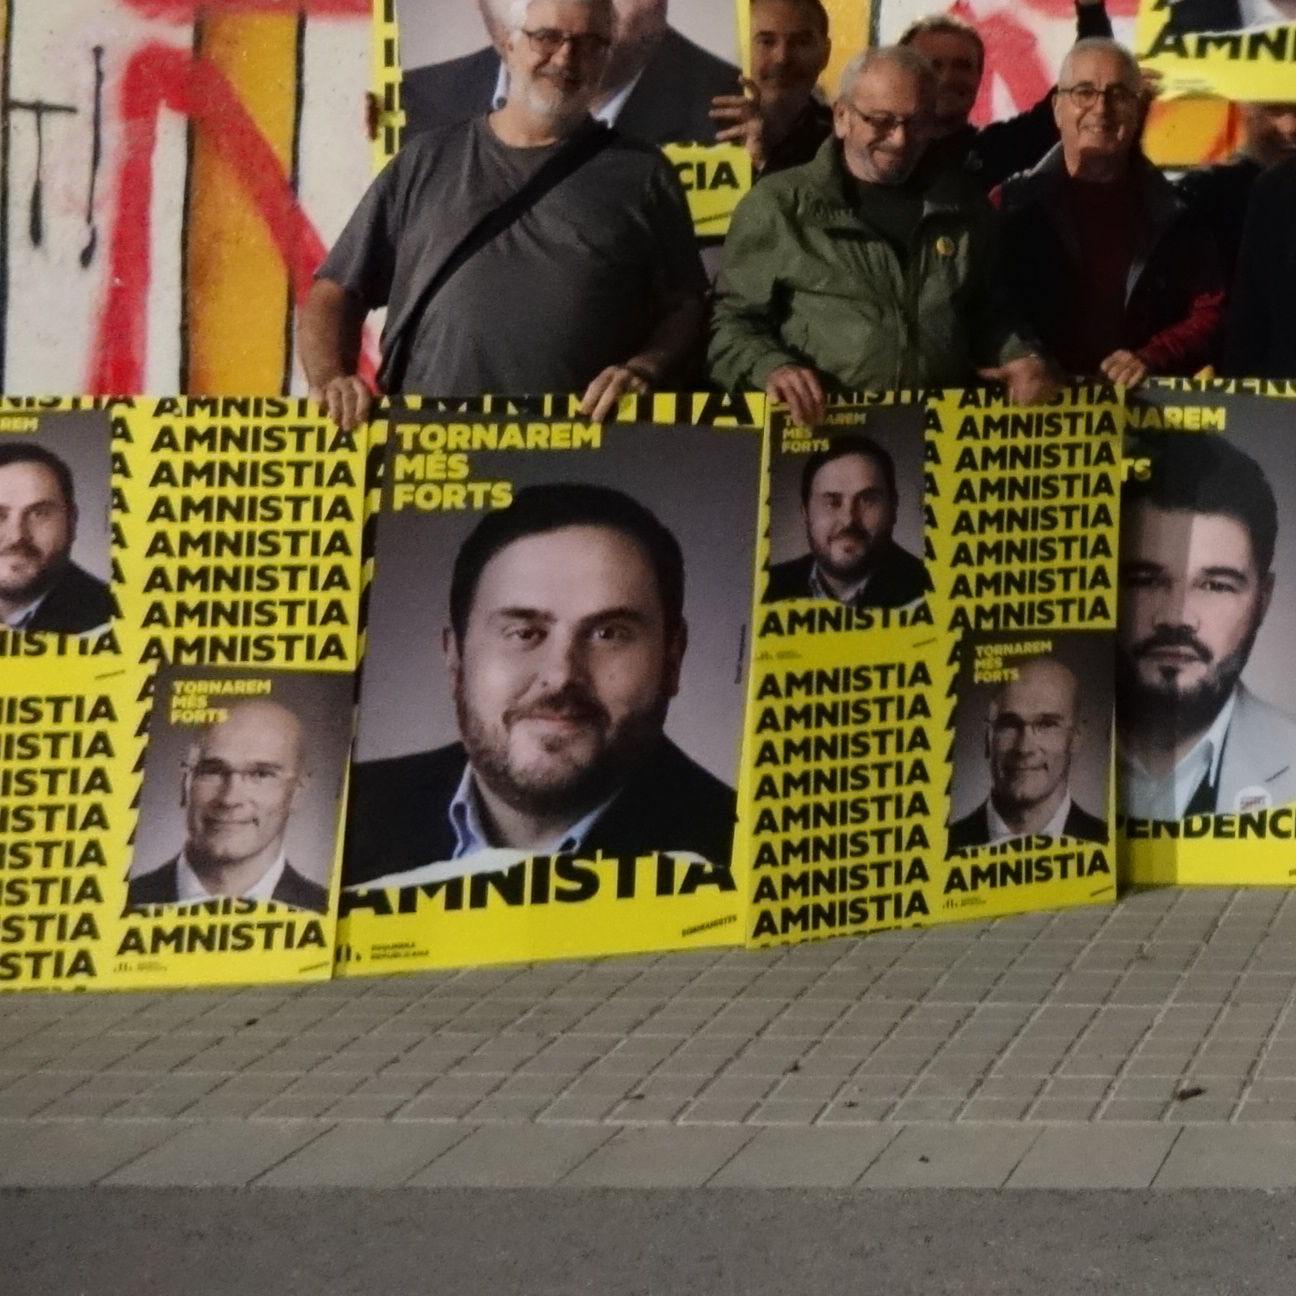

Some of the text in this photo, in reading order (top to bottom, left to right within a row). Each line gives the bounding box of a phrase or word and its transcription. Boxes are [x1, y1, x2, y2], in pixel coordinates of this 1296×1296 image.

[151, 424, 358, 453] AMNISTIA
[395, 423, 601, 450] TORNAREM
[956, 410, 1118, 441] AMNISTIA
[782, 439, 830, 453] FORTS
[954, 441, 1116, 472] AMNISTIA
[148, 460, 356, 488] AMNISTIA
[394, 450, 469, 481] MÉS
[393, 482, 513, 510] FORTS
[953, 472, 1114, 504] AMNISTIA
[147, 495, 354, 523] AMNISTIA
[951, 503, 1113, 536] AMNISTIA
[145, 530, 352, 558] AMNISTIA
[950, 534, 1112, 568] AMNISTIA
[143, 565, 350, 593] AMNISTIA
[948, 565, 1111, 600] AMNISTIA
[141, 600, 349, 629] AMNISTIA
[759, 601, 934, 639] AMNISTIA
[947, 596, 1110, 633] AMNISTIA
[138, 633, 347, 664] AMNISTIA
[974, 641, 1052, 658] TORNAREM
[172, 680, 272, 697] TORNAREM
[757, 661, 932, 701] AMNISTIA
[974, 669, 1019, 683] FORTS
[170, 708, 228, 725] FORTS
[755, 693, 931, 733] AMNISTIA
[754, 726, 930, 768] AMNISTIA
[754, 758, 930, 801] AMNISTIA
[753, 791, 930, 836] AMNISTIA
[753, 824, 930, 870] AMNISTIA
[337, 855, 737, 918] AMNISTIA
[752, 857, 930, 904] AMNISTIA
[943, 850, 1110, 895] AMNISTIA
[752, 890, 930, 938] AMNISTIA
[116, 920, 327, 957] AMNISTIA
